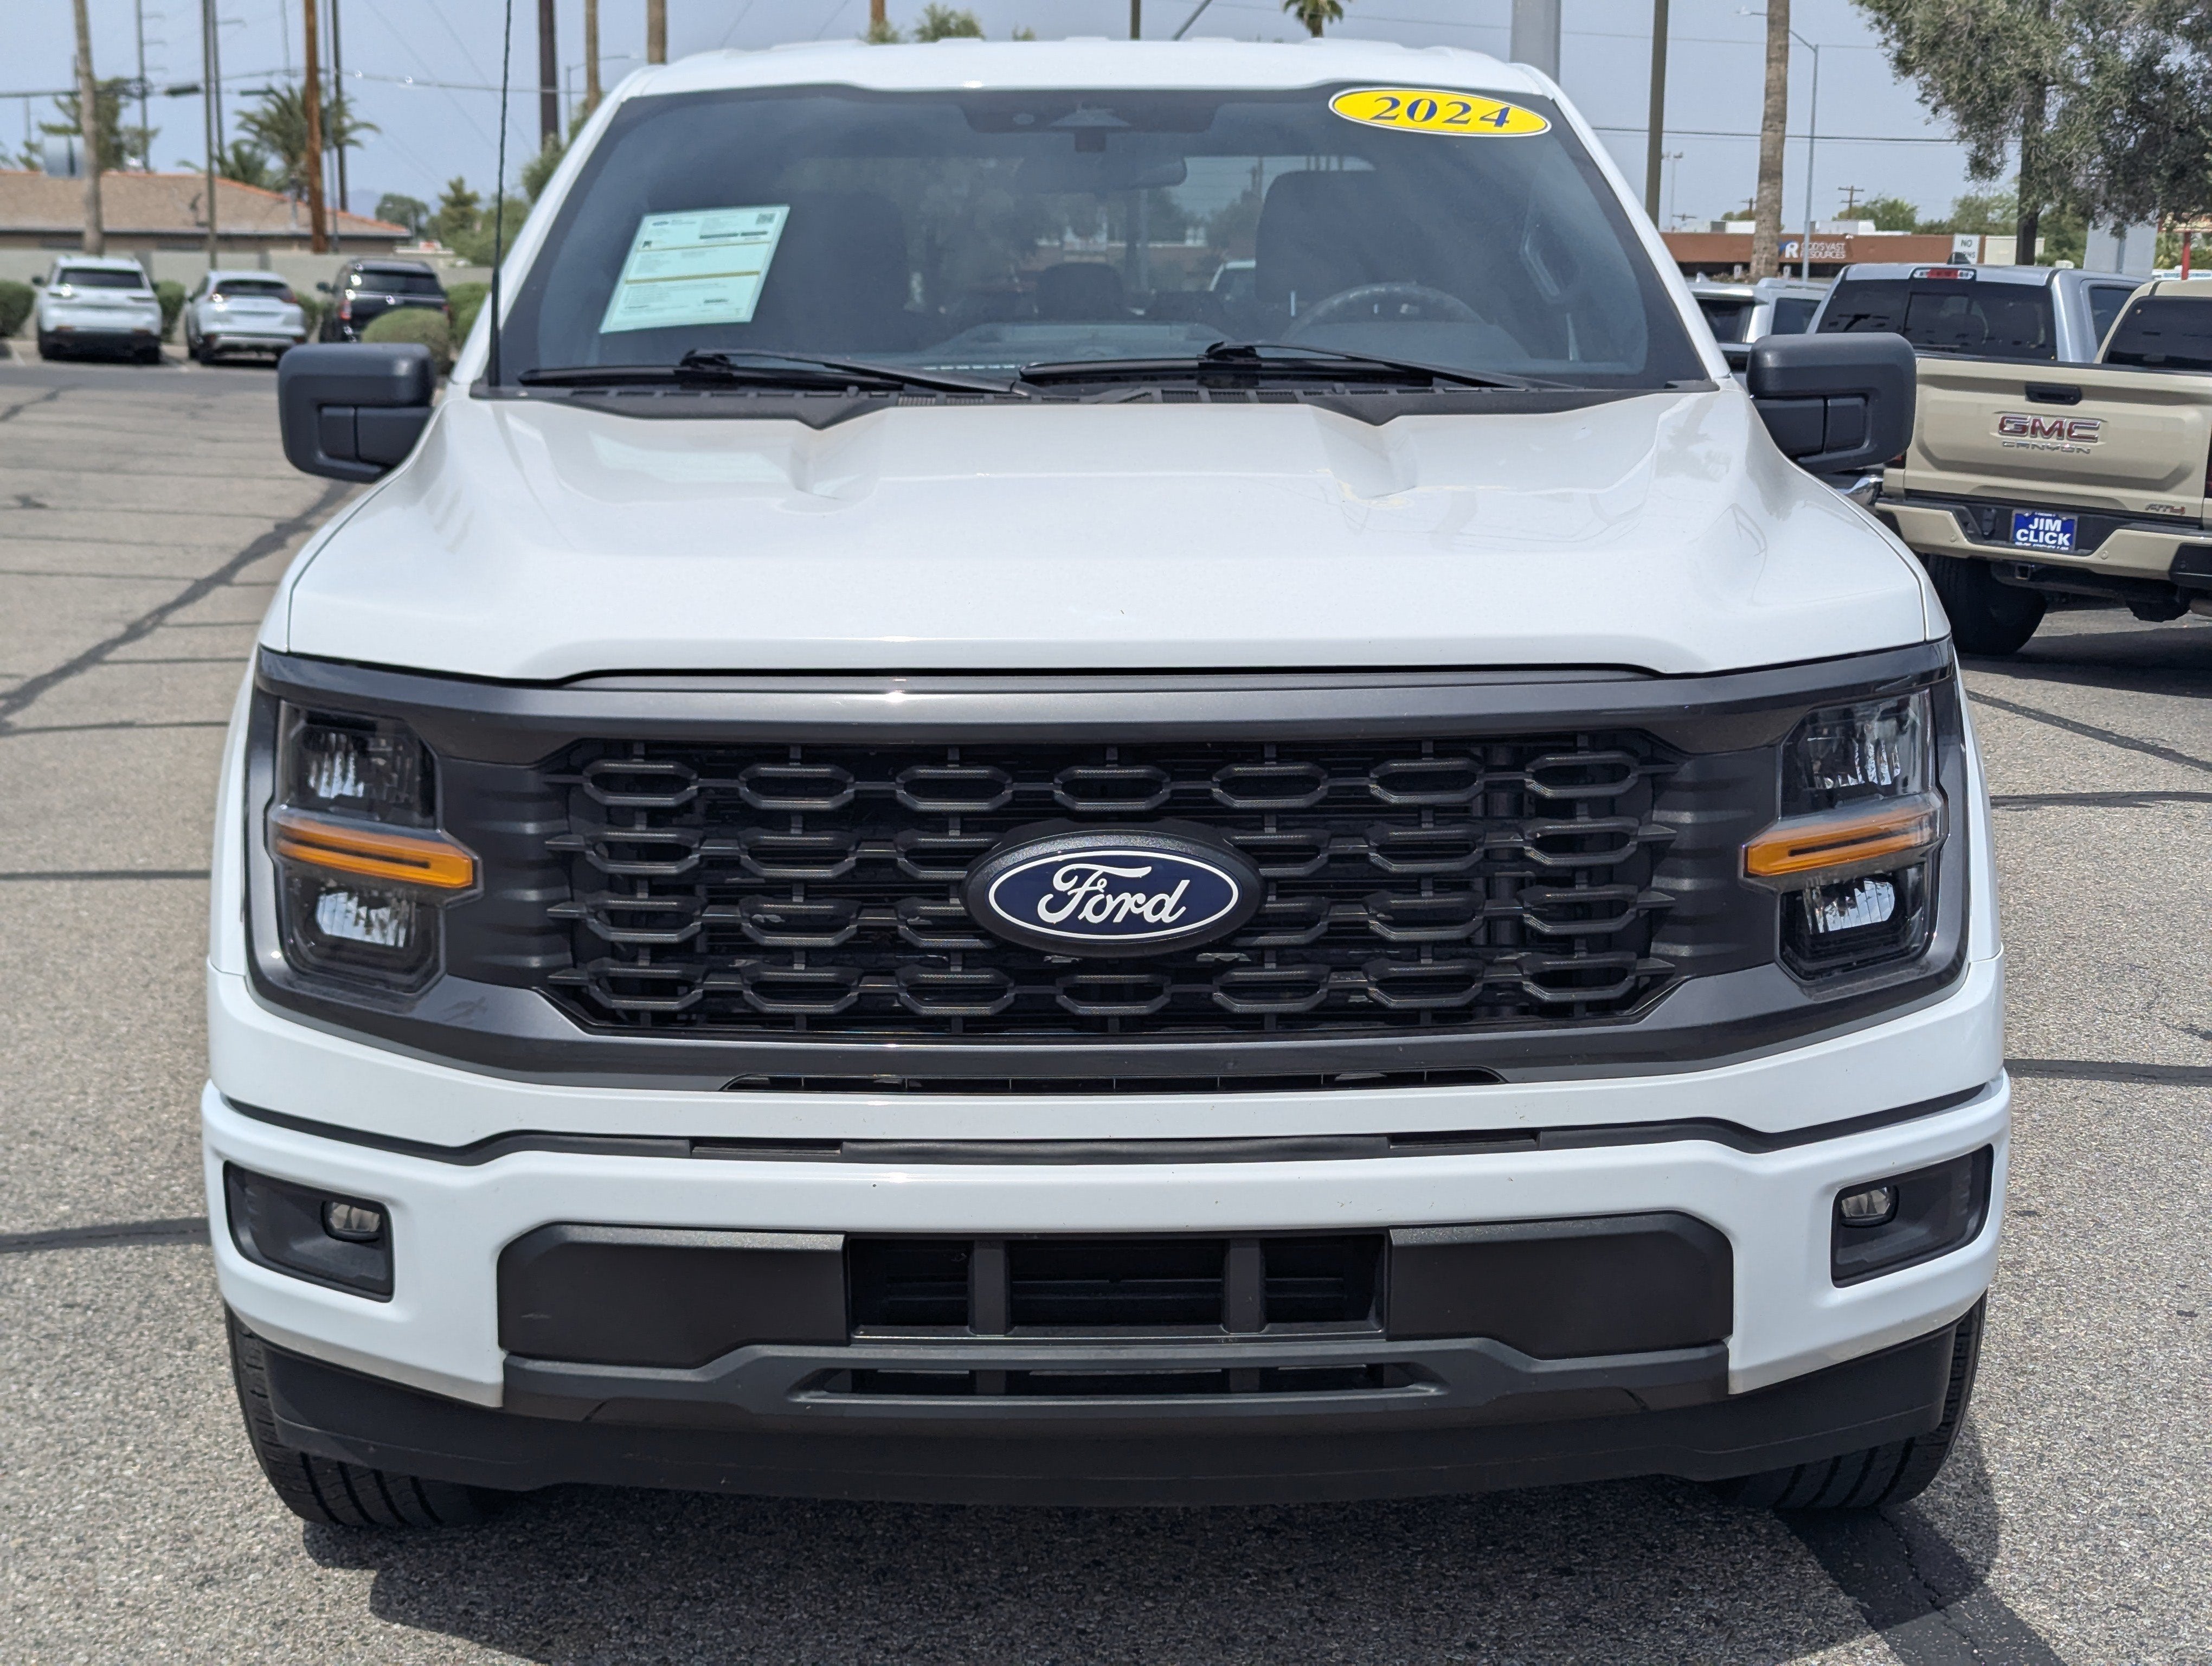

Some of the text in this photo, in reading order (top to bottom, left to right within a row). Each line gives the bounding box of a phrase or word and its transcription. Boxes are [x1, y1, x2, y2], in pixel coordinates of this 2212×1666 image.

[1369, 97, 1511, 128] 2024
[1785, 241, 1798, 258] R
[1960, 239, 1973, 247] NO
[1800, 250, 1846, 259] RSOURCES
[1998, 414, 2100, 443] GMC
[2002, 440, 2091, 454] CANYON
[2028, 517, 2062, 531] JIM
[2016, 529, 2071, 546] CLICK
[1037, 863, 1190, 924] Ford
